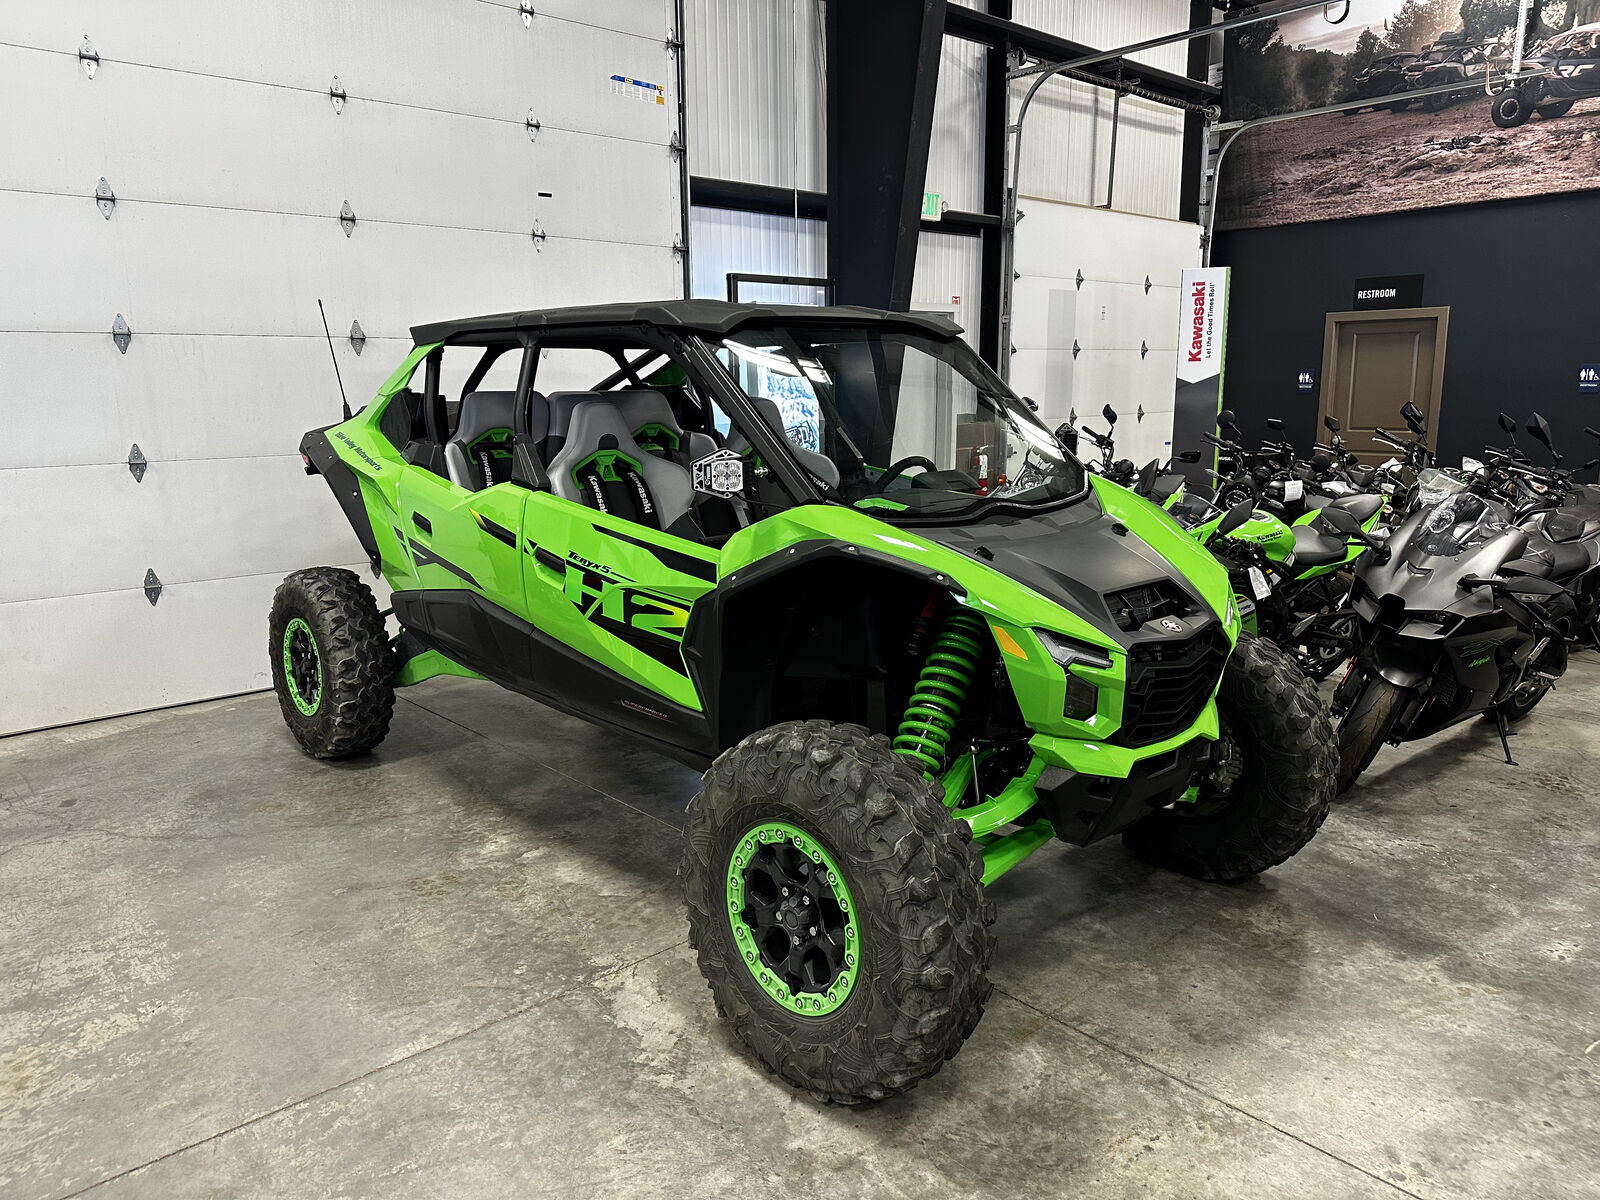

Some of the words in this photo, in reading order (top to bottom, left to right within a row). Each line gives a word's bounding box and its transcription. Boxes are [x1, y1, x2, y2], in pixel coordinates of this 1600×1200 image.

[1207, 298, 1215, 318] Times
[1357, 288, 1397, 300] RESTROOM
[1188, 281, 1206, 362] Kawasaki
[627, 471, 653, 514] Kawasaki
